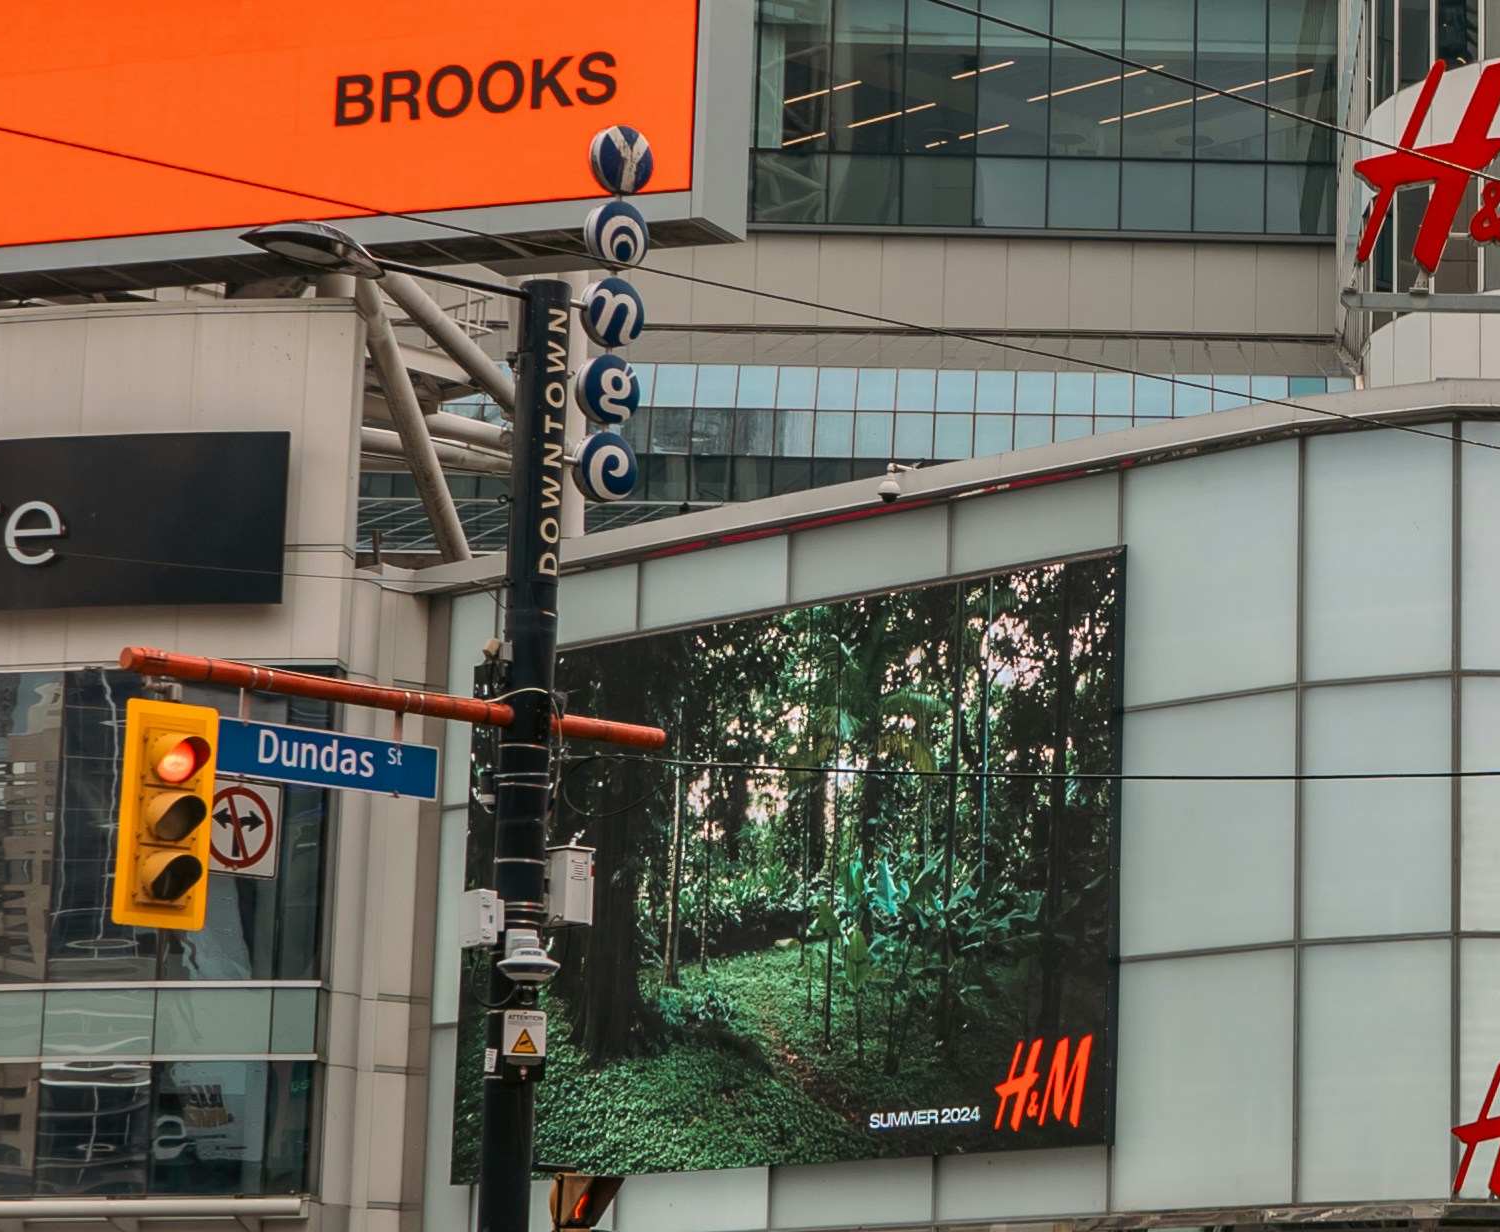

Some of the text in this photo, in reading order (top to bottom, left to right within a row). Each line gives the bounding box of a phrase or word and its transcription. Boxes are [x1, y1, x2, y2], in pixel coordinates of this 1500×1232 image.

[333, 50, 619, 127] BROOKS
[536, 307, 569, 576] DOWNTOWN
[256, 729, 404, 780] Dundas St
[507, 1013, 544, 1022] ATTENTION
[992, 1033, 1095, 1132] H&M
[868, 1106, 981, 1129] SUMMER 2024
